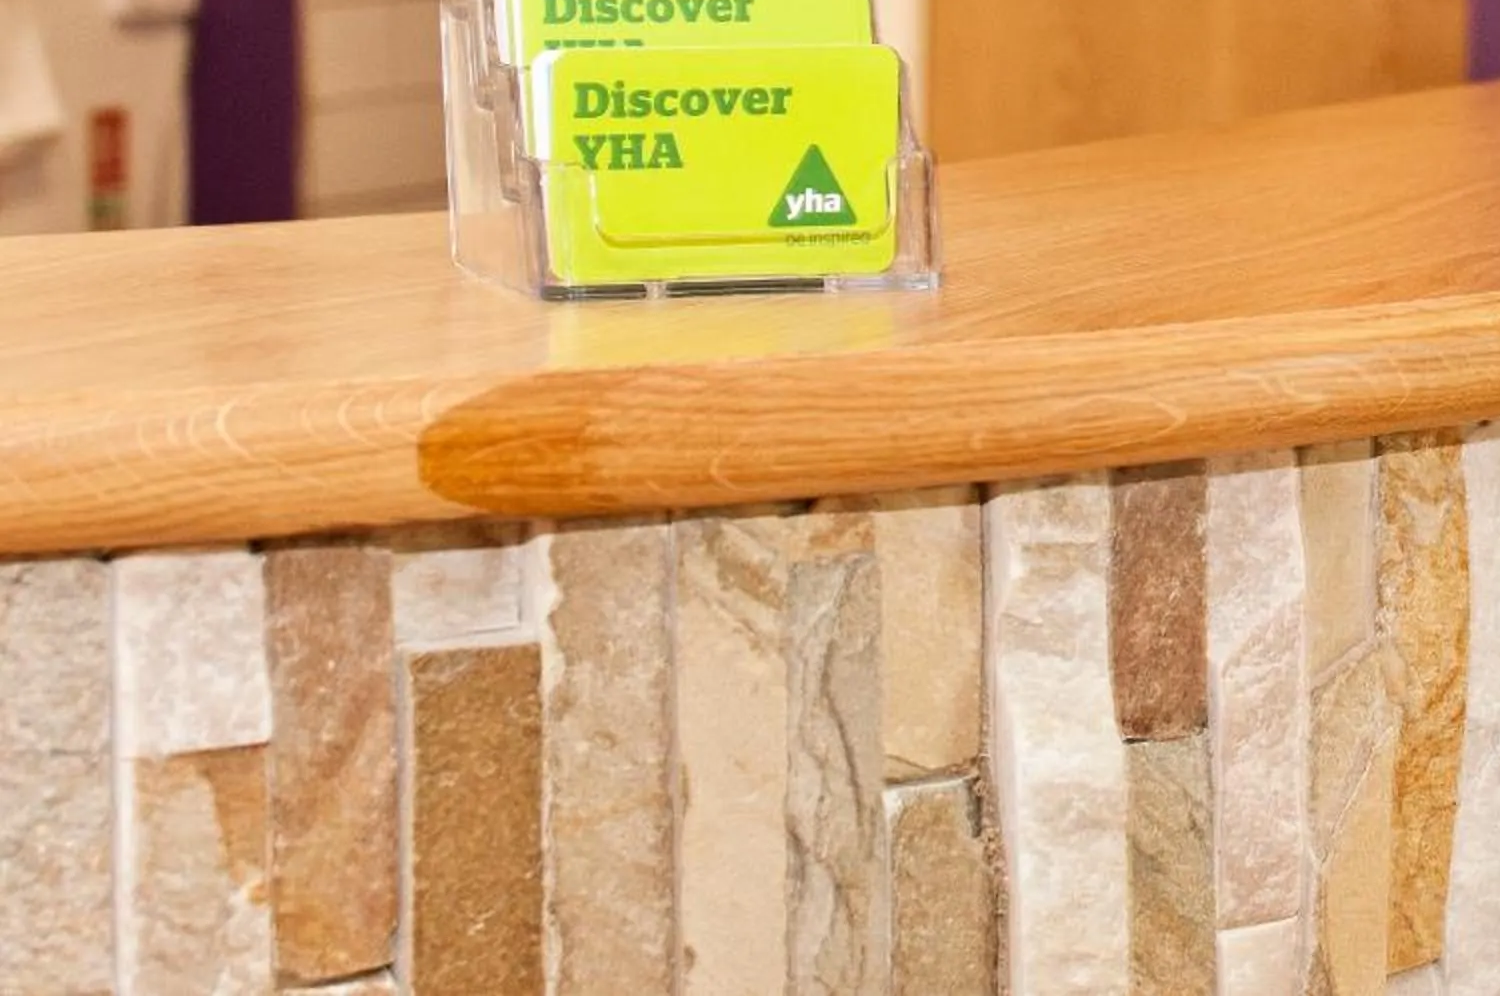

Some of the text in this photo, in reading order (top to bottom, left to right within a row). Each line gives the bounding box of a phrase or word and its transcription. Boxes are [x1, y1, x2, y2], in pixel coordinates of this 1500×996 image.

[573, 80, 793, 119] Discover
[573, 132, 684, 171] YHA
[785, 187, 843, 221] yha
